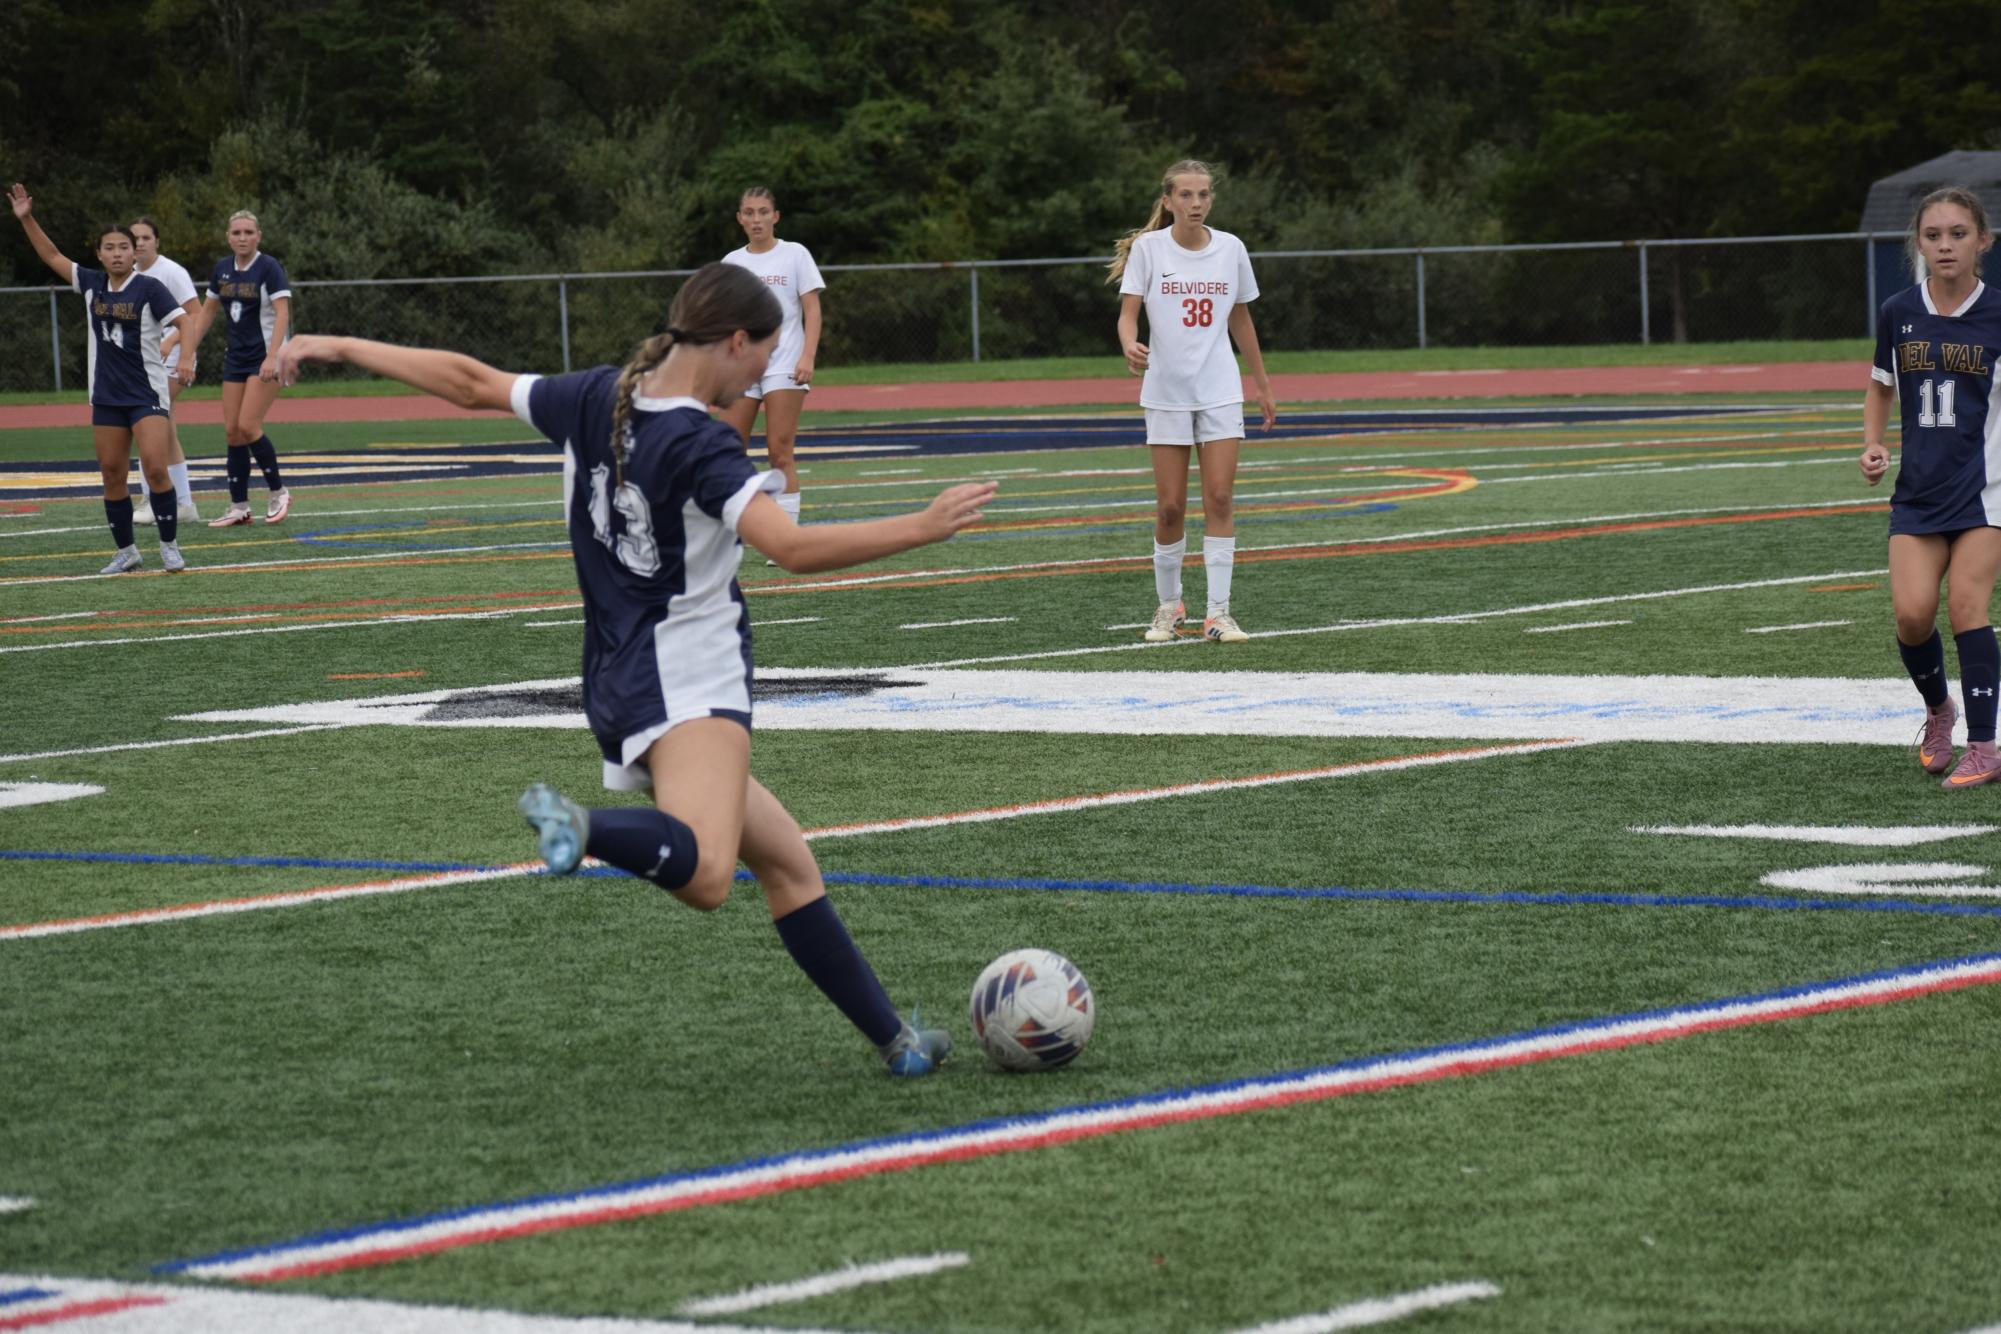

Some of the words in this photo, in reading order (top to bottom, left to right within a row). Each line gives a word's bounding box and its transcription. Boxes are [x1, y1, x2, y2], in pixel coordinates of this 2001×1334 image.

[1161, 281, 1229, 295] BELVIDERE
[1182, 298, 1214, 328] 38
[100, 320, 124, 349] 14
[1941, 343, 1988, 375] VAL
[1918, 379, 1956, 427] 11
[587, 461, 662, 578] 13
